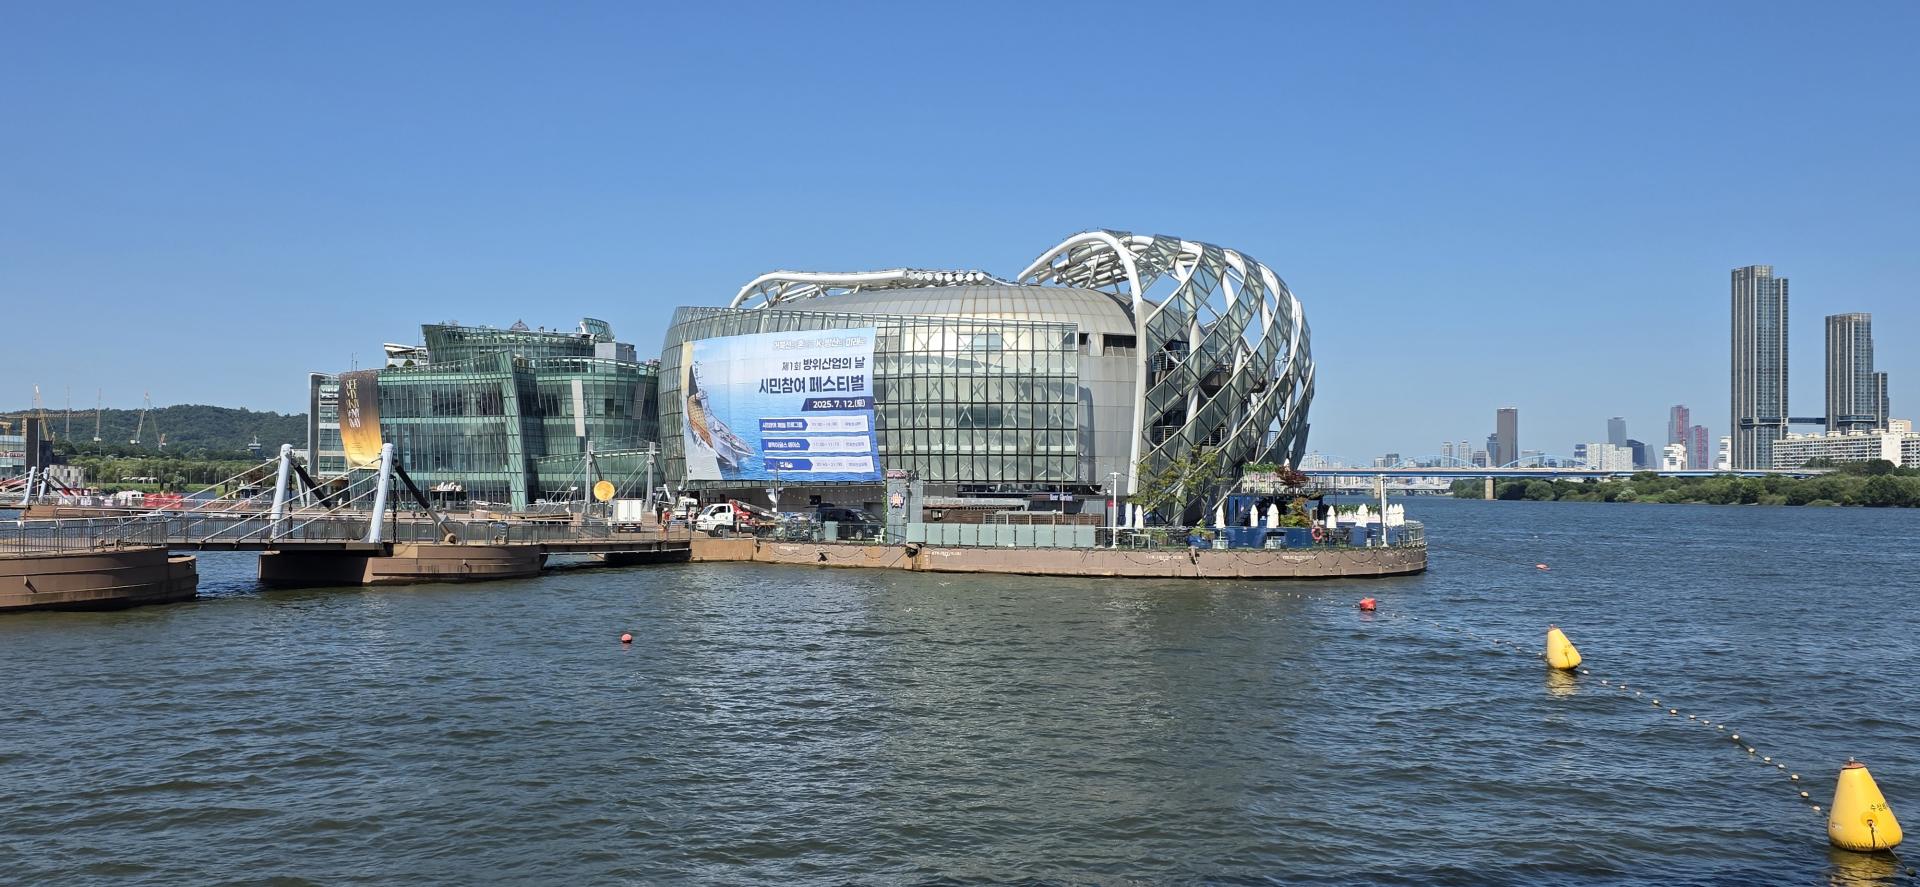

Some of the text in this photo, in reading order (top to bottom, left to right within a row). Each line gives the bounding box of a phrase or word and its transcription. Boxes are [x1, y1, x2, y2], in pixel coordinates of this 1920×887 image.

[782, 356, 866, 371] 제1회 방위산업의 날
[759, 374, 865, 394] 시민참여 페스티벌
[813, 401, 833, 409] 2025.
